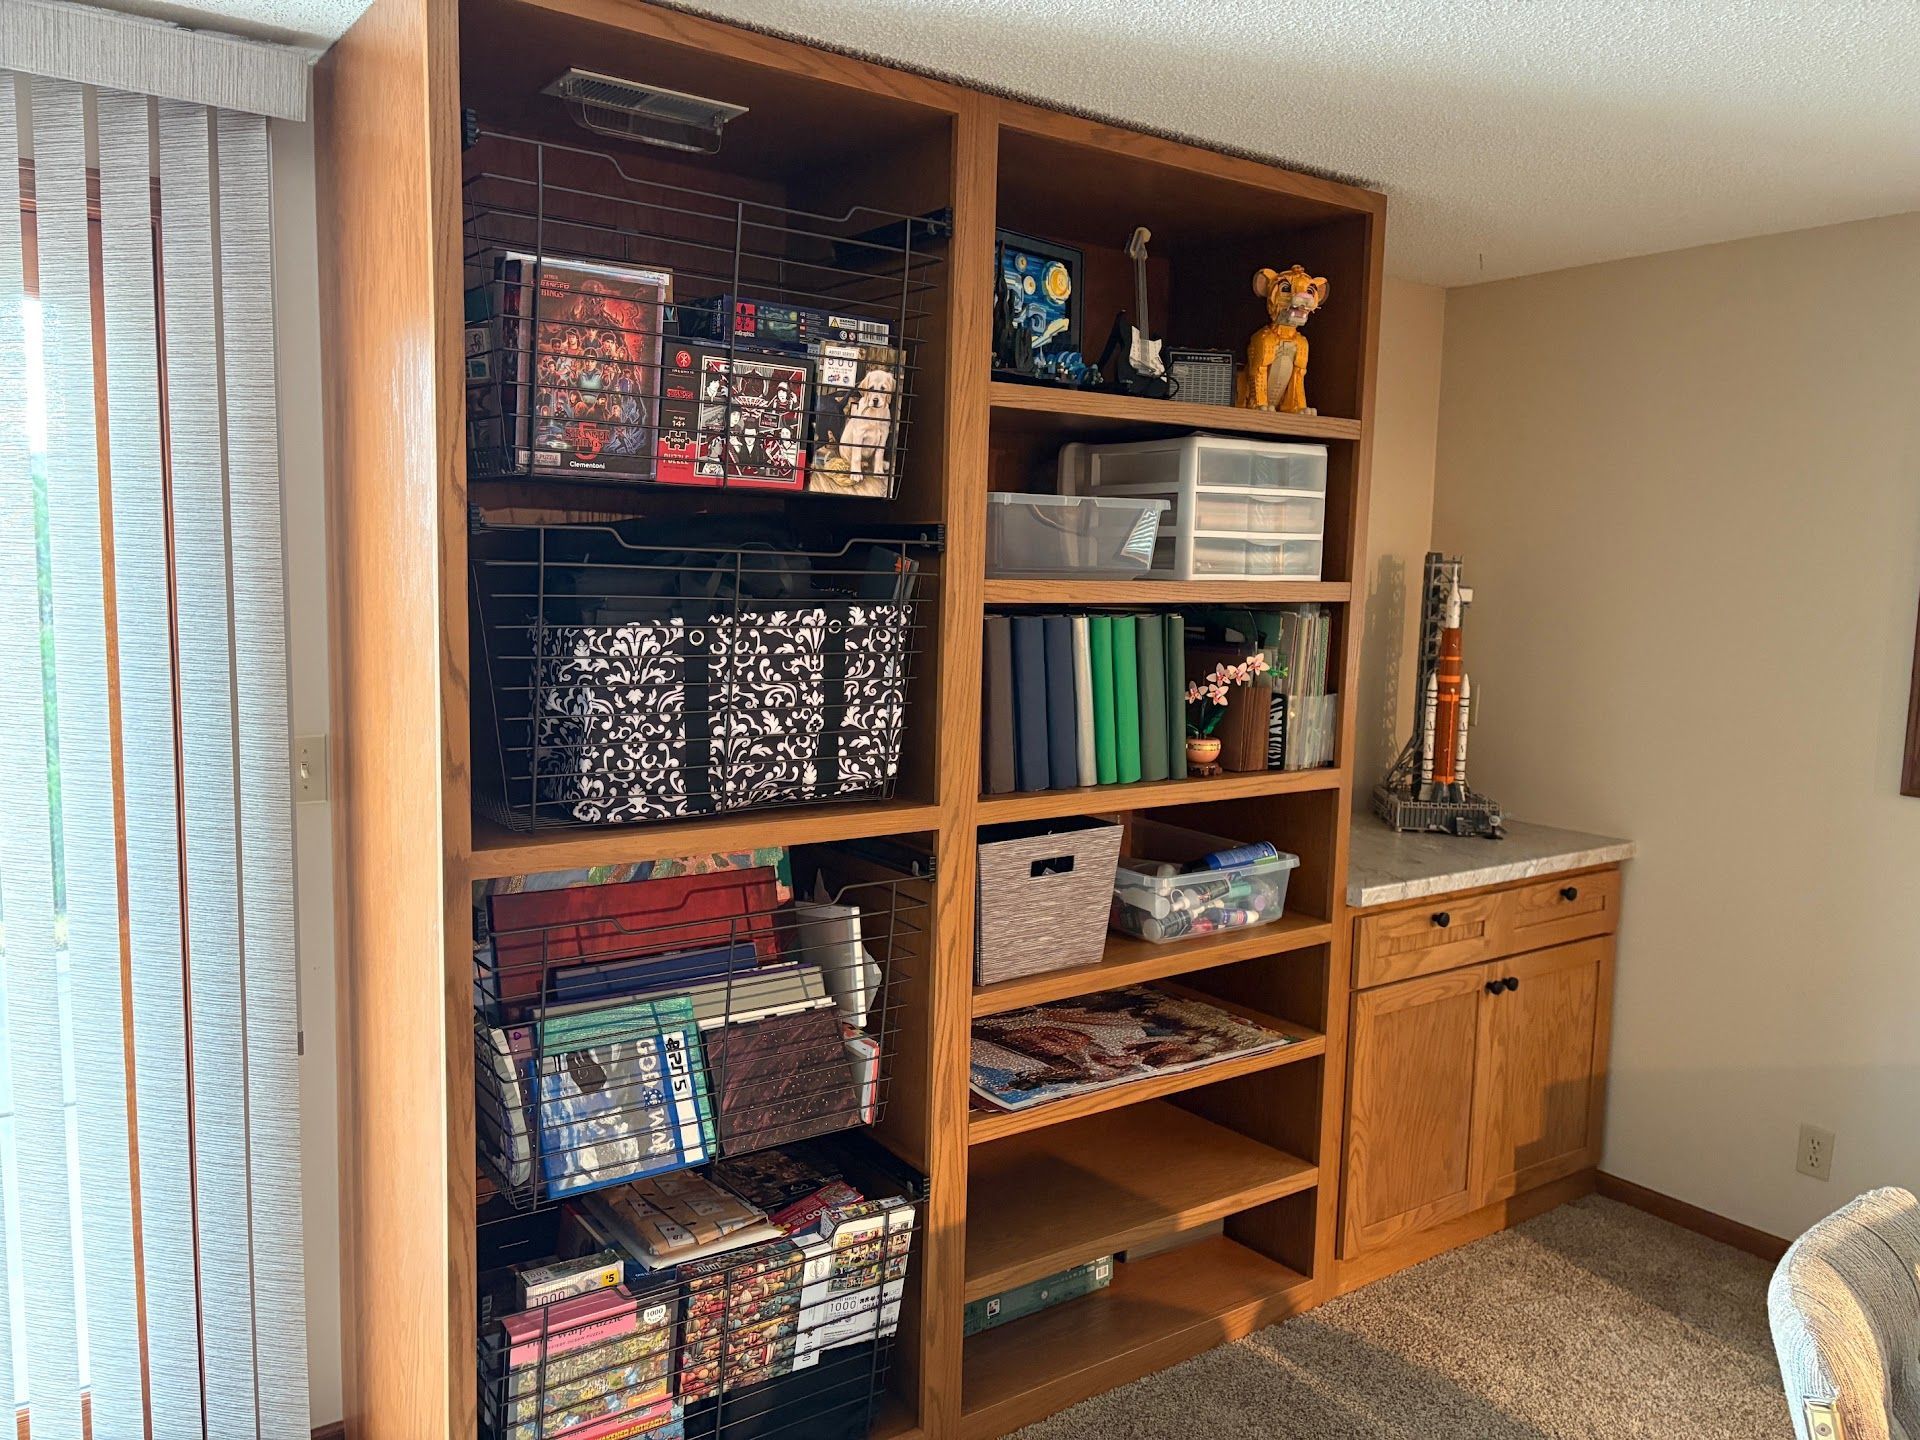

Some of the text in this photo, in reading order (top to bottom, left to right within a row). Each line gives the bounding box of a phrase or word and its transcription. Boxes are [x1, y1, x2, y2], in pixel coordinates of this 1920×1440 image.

[569, 460, 606, 470] Clementoni
[605, 1273, 615, 1283] $5
[829, 1300, 857, 1312] 1000
